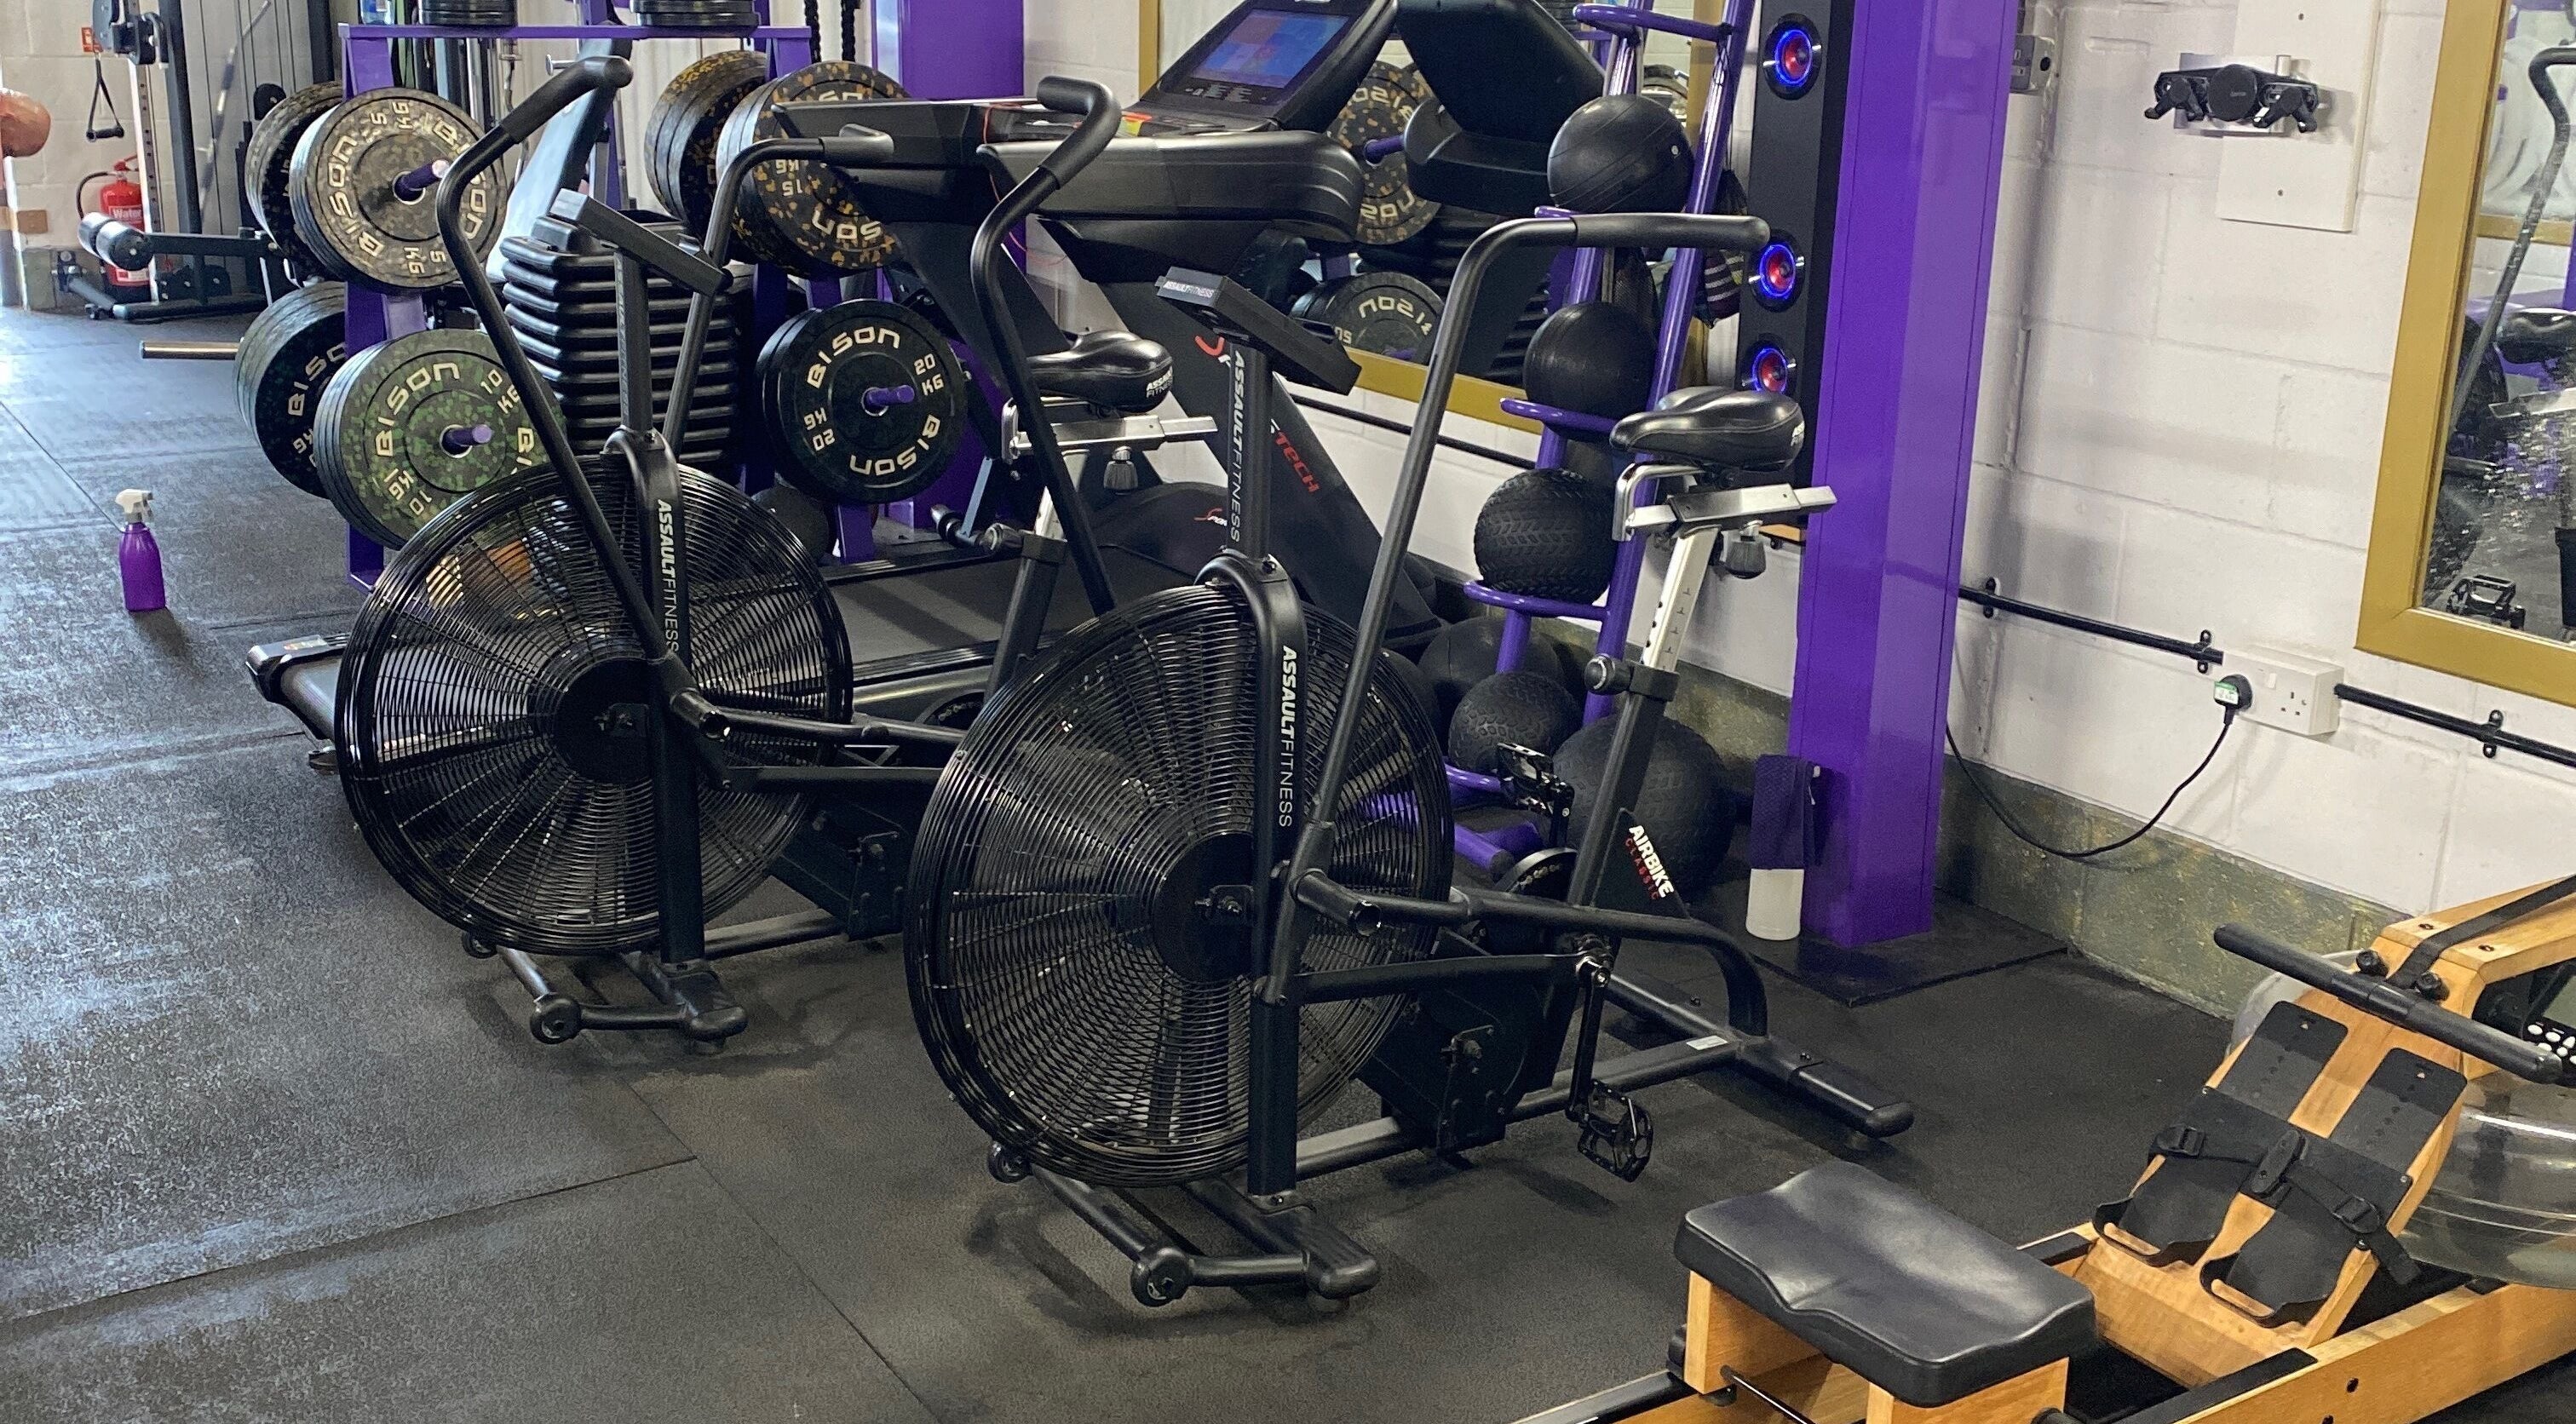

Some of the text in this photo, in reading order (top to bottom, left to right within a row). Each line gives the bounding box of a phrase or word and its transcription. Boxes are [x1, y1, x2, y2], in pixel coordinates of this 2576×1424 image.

[370, 112, 388, 126] 5
[392, 101, 415, 129] KG
[327, 135, 384, 257] BISON
[781, 179, 803, 197] 15
[403, 246, 425, 274] KG
[430, 250, 446, 263] 5
[807, 326, 900, 388] BISON
[913, 353, 936, 376] 20
[288, 343, 345, 416] BISO
[480, 369, 503, 394] 10
[922, 373, 945, 396] KG
[375, 362, 460, 456] BISON
[804, 407, 827, 431] KG
[812, 428, 836, 451] 20
[849, 414, 941, 476] BISON
[409, 490, 433, 516] 10
[1629, 824, 1675, 899] AIRBIKE
